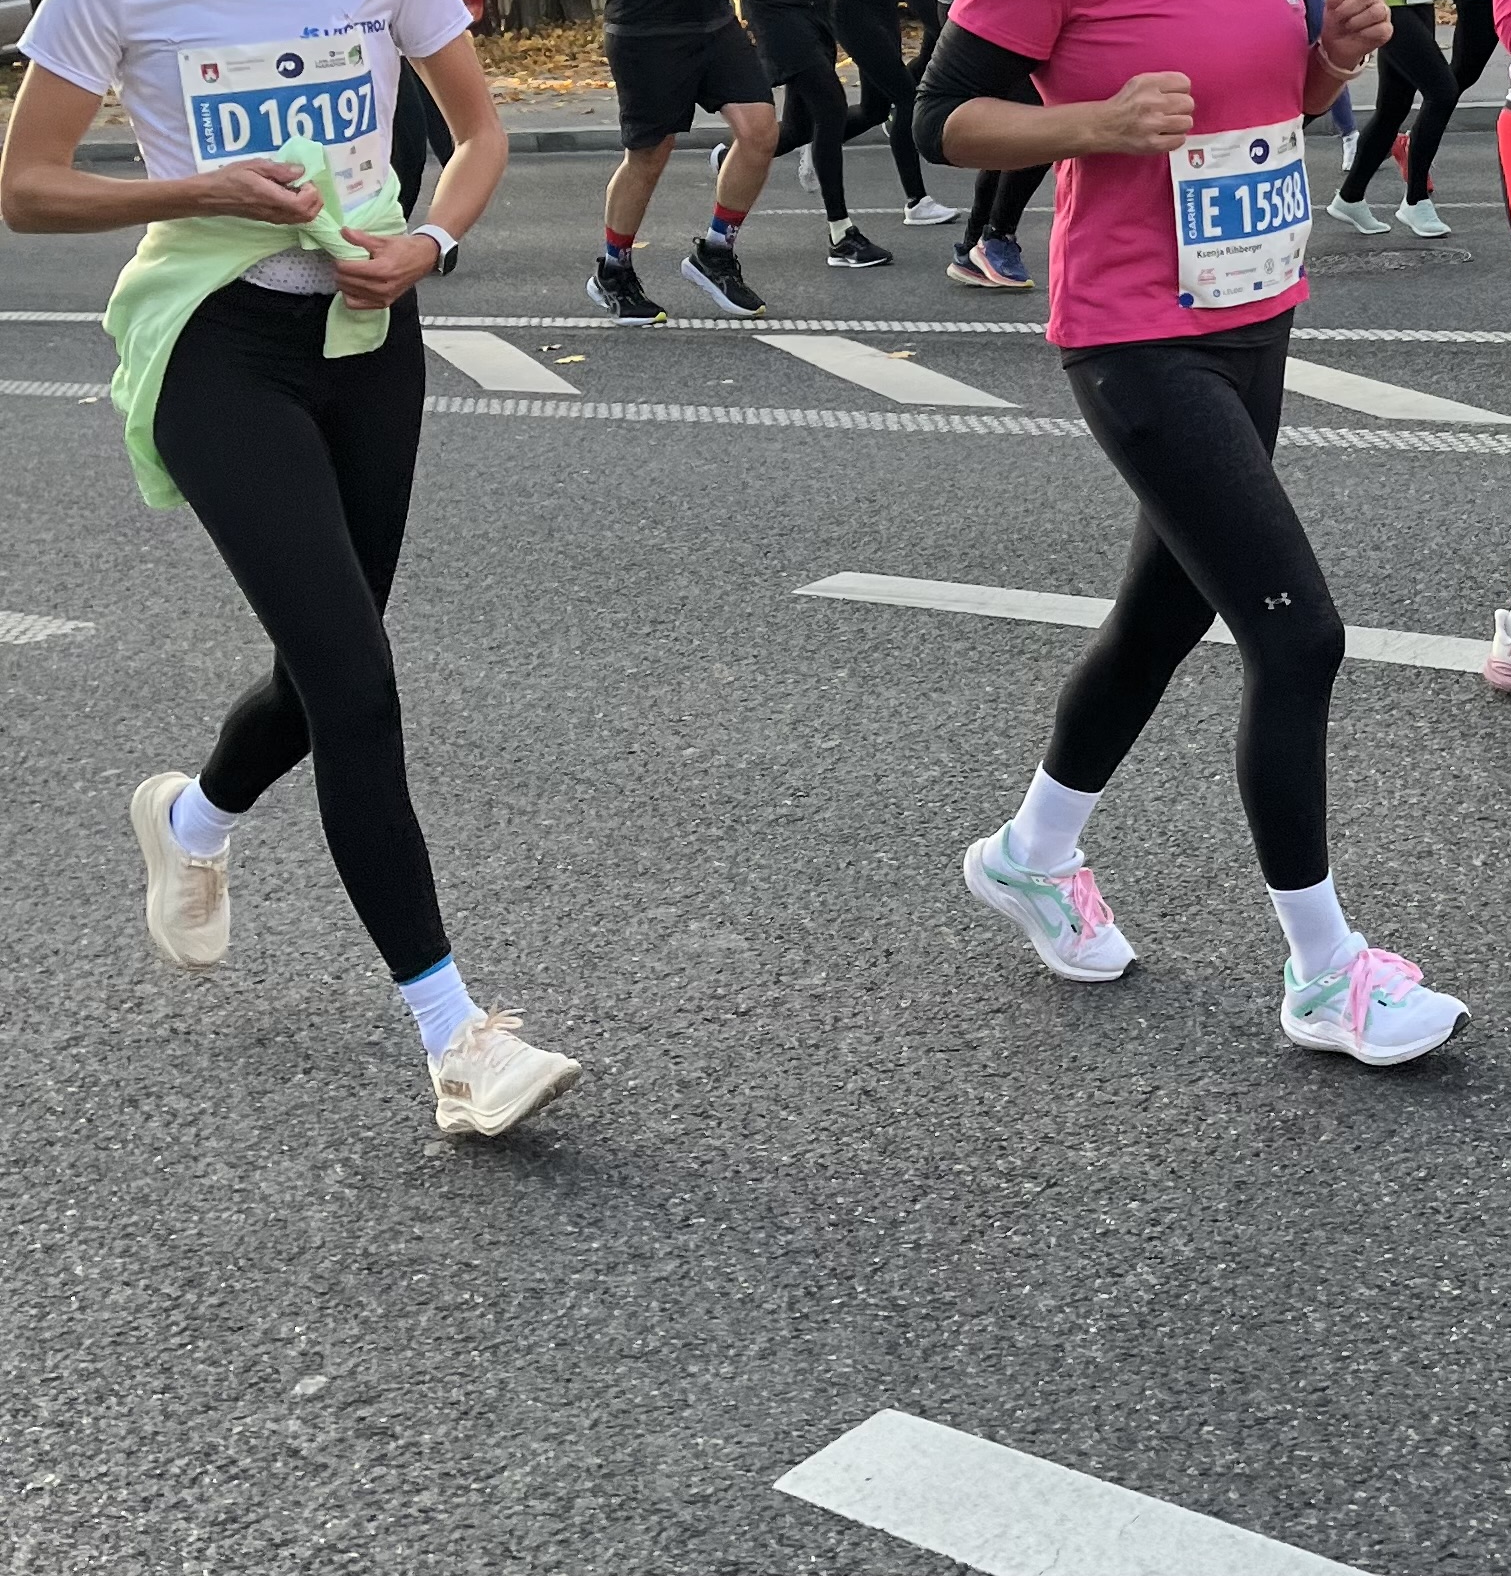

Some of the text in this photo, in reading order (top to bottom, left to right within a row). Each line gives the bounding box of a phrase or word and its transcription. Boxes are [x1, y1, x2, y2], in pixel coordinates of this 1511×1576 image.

[200, 102, 217, 154] GARMIN
[218, 83, 372, 152] D 16197
[1185, 187, 1198, 239] GARMIN
[1202, 171, 1304, 237] E 15588
